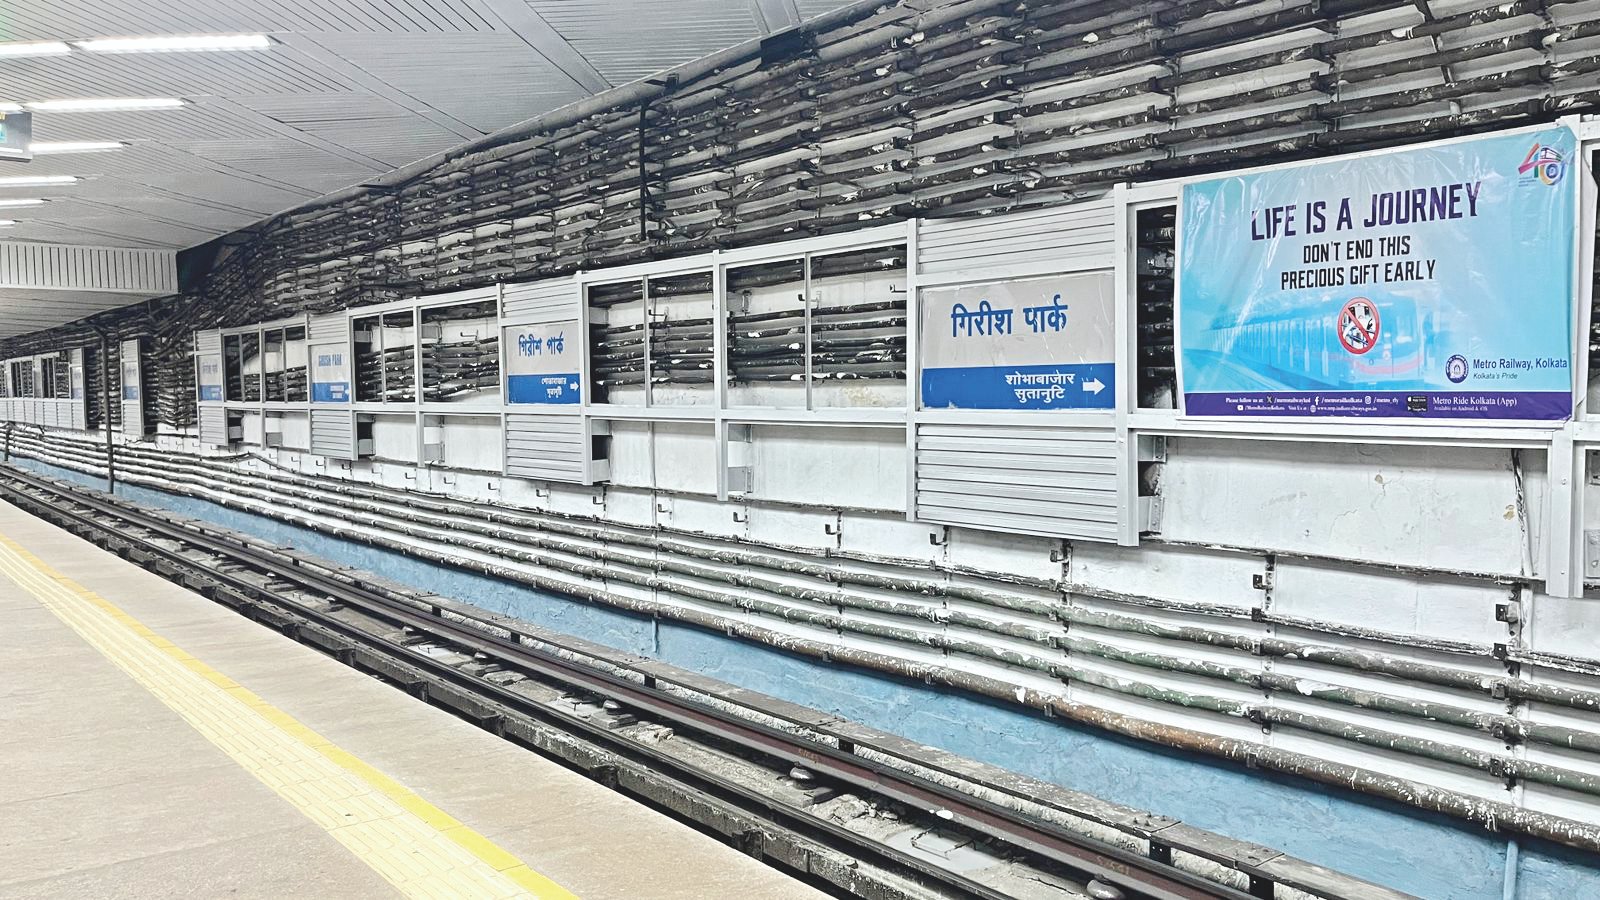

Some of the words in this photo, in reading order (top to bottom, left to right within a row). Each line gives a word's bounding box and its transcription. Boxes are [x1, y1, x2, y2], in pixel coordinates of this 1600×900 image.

[1251, 204, 1296, 241] LIFE
[1306, 200, 1327, 234] IS
[1336, 197, 1353, 231] A
[1363, 181, 1481, 228] JOURNEY
[1303, 239, 1341, 264] DON'T
[1347, 237, 1374, 260] END
[1379, 235, 1411, 258] THIS
[1281, 266, 1345, 290] PRECIOUS
[1350, 264, 1379, 284] GIFT
[1384, 259, 1436, 282] EARLY
[951, 300, 1013, 337] गिरीश
[1022, 294, 1068, 333] पार्क
[1473, 358, 1497, 369] Metro
[1499, 358, 1534, 371] Railway,
[1535, 357, 1568, 368] Kolkata
[1473, 372, 1500, 380] Kolkata's
[1501, 372, 1518, 380] Pride
[1014, 384, 1066, 403] सुतानुटि
[1433, 396, 1452, 405] Metro
[1453, 396, 1469, 405] Ride
[1470, 396, 1496, 405] Kolkata
[1497, 396, 1518, 407] (App)
